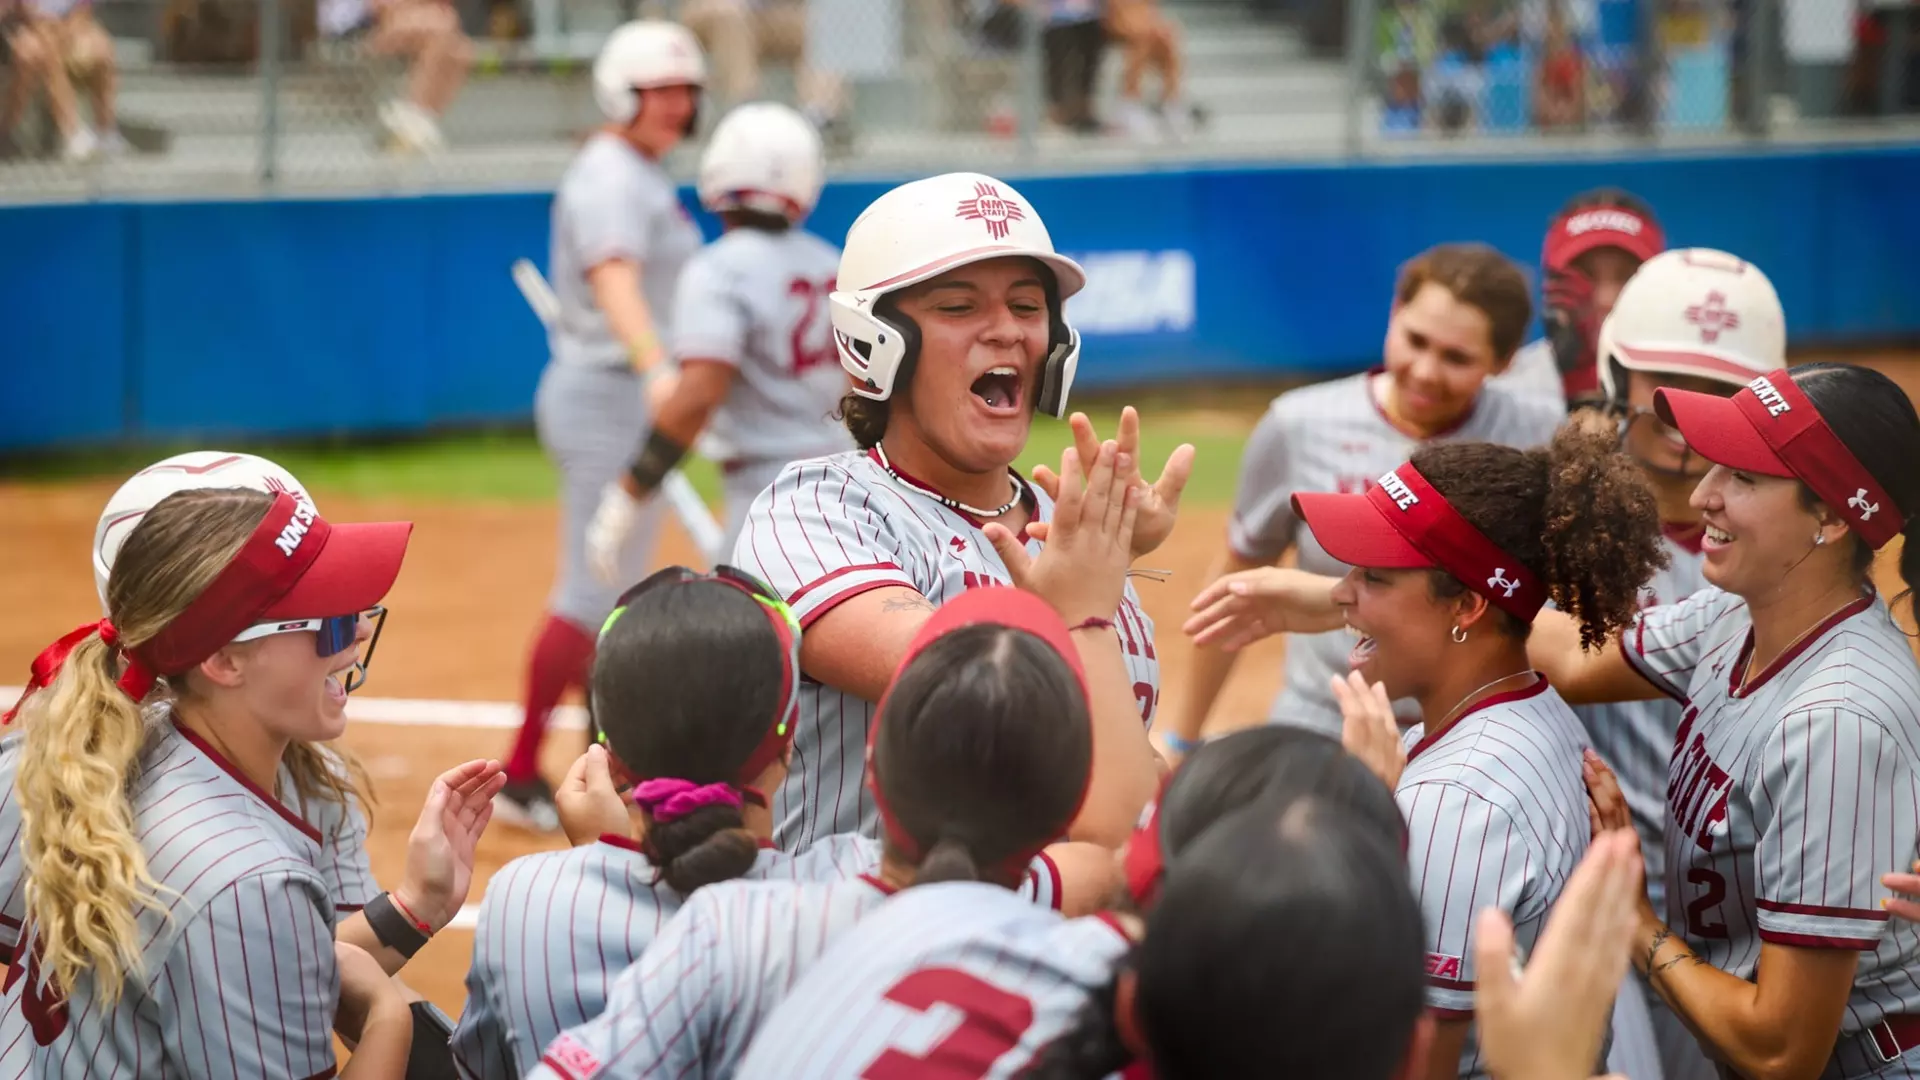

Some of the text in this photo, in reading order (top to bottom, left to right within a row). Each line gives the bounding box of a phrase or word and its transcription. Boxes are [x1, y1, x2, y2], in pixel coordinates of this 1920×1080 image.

[980, 199, 1004, 209] NM
[981, 209, 1006, 217] STATE
[274, 515, 309, 558] NM
[1687, 867, 1727, 939] 2
